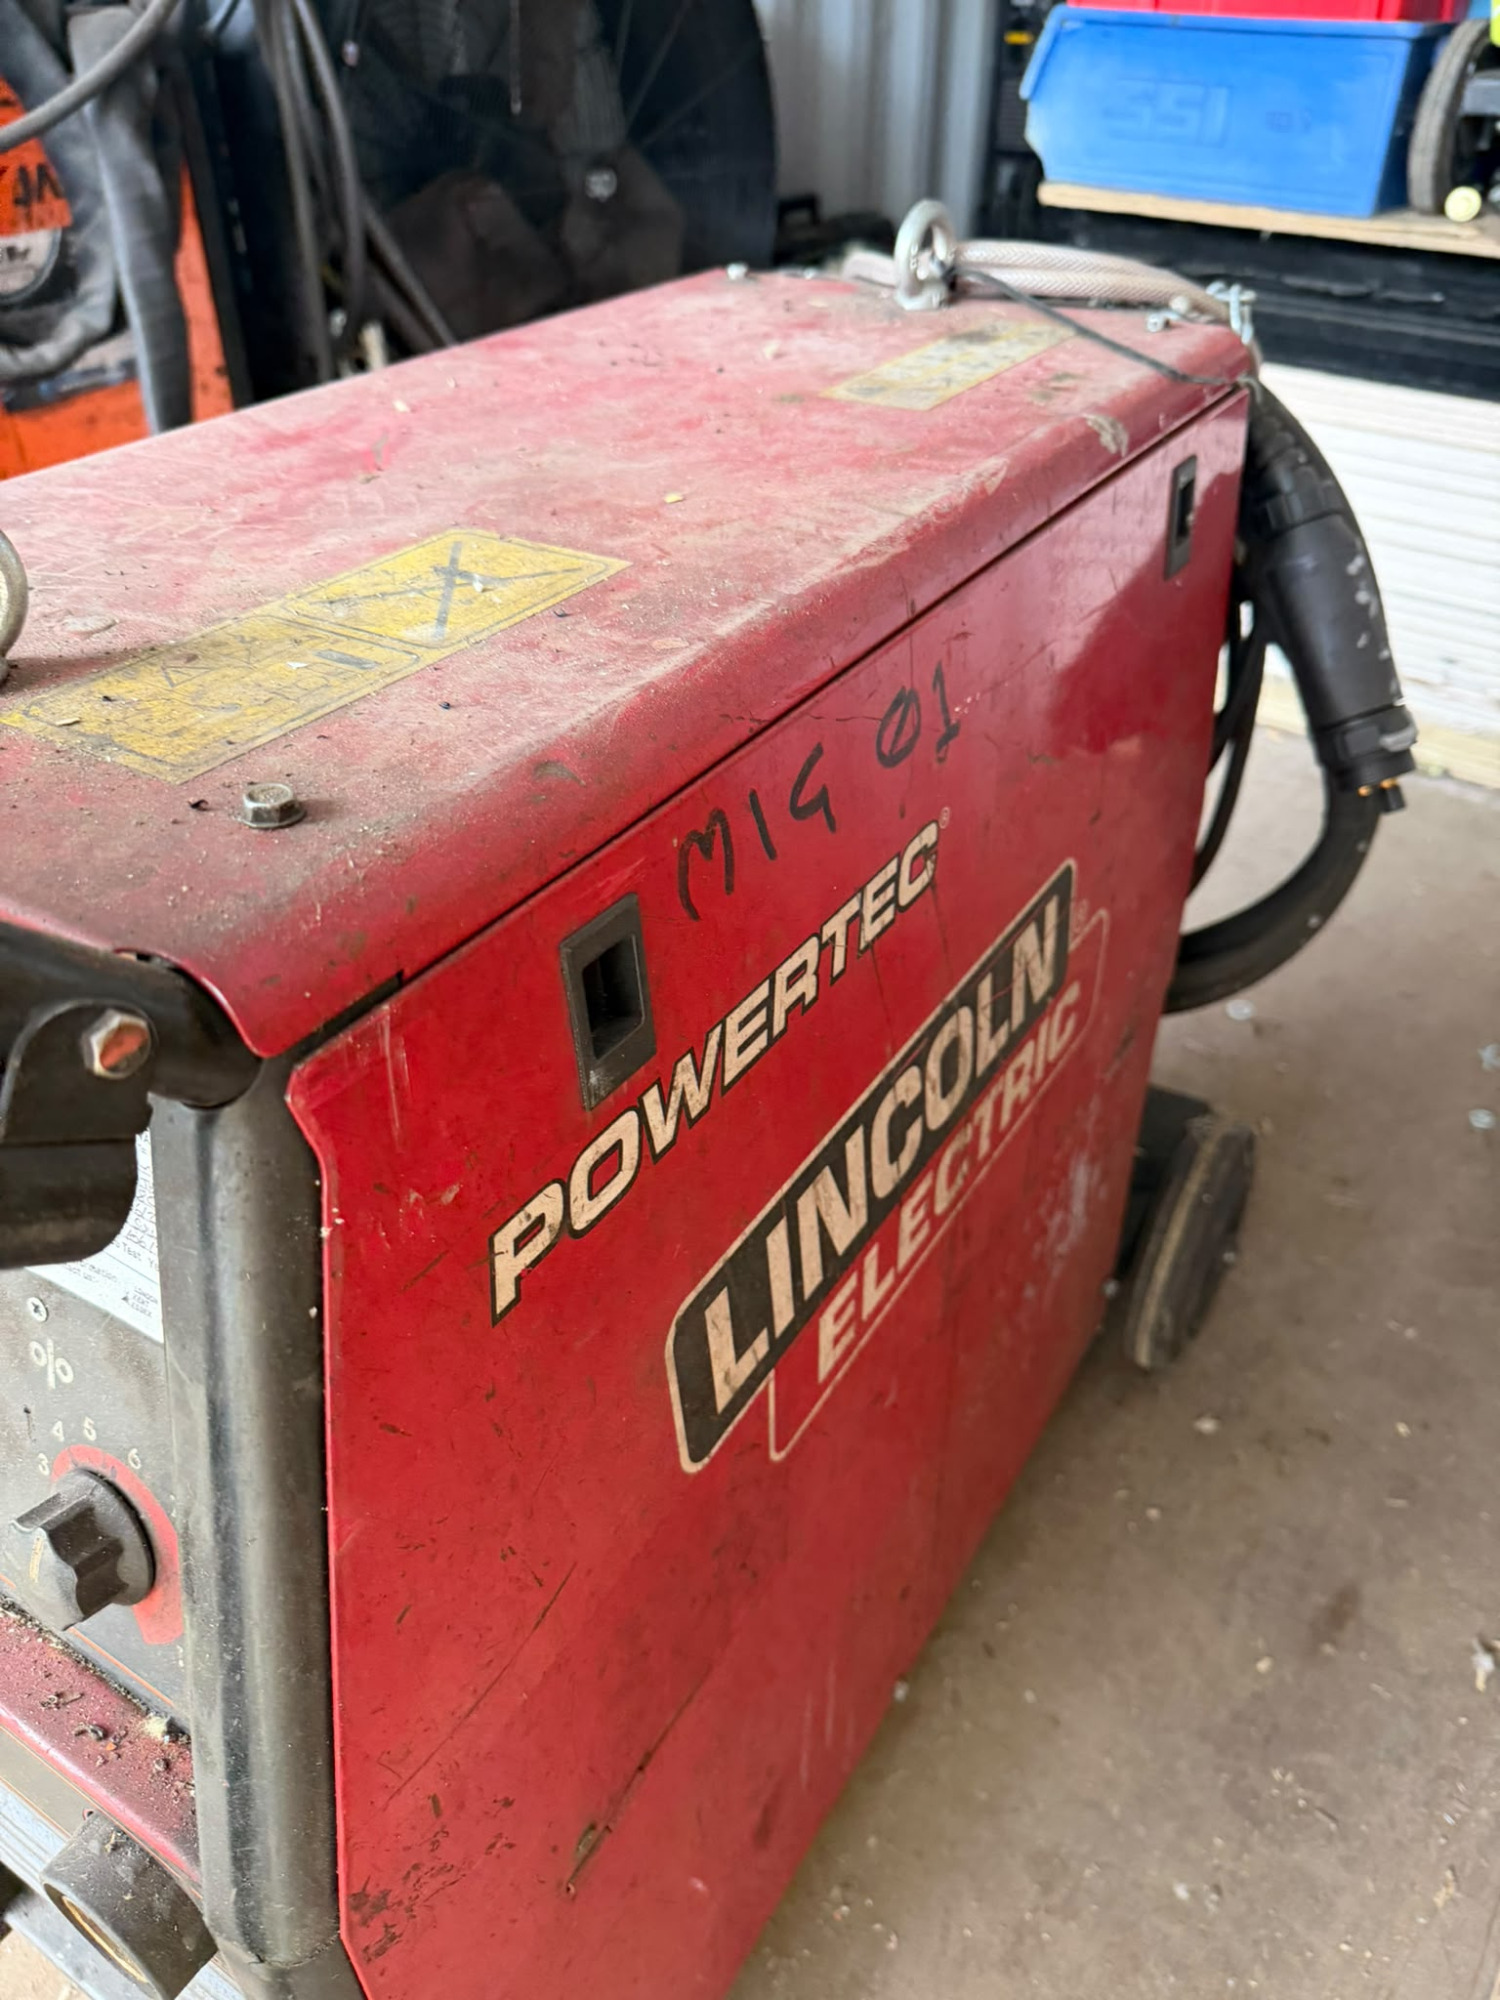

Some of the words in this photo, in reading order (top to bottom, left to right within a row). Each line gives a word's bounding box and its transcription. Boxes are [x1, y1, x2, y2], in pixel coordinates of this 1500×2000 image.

[678, 742, 837, 921] MIG
[490, 820, 939, 1327] POWERTEC
[704, 894, 1060, 1414] LINCOLN
[818, 982, 1080, 1384] ELECTRIC
[29, 1337, 74, 1389] %
[38, 1453, 50, 1476] 3
[51, 1420, 65, 1442] 4
[82, 1416, 97, 1441] 5
[128, 1448, 141, 1469] 6
